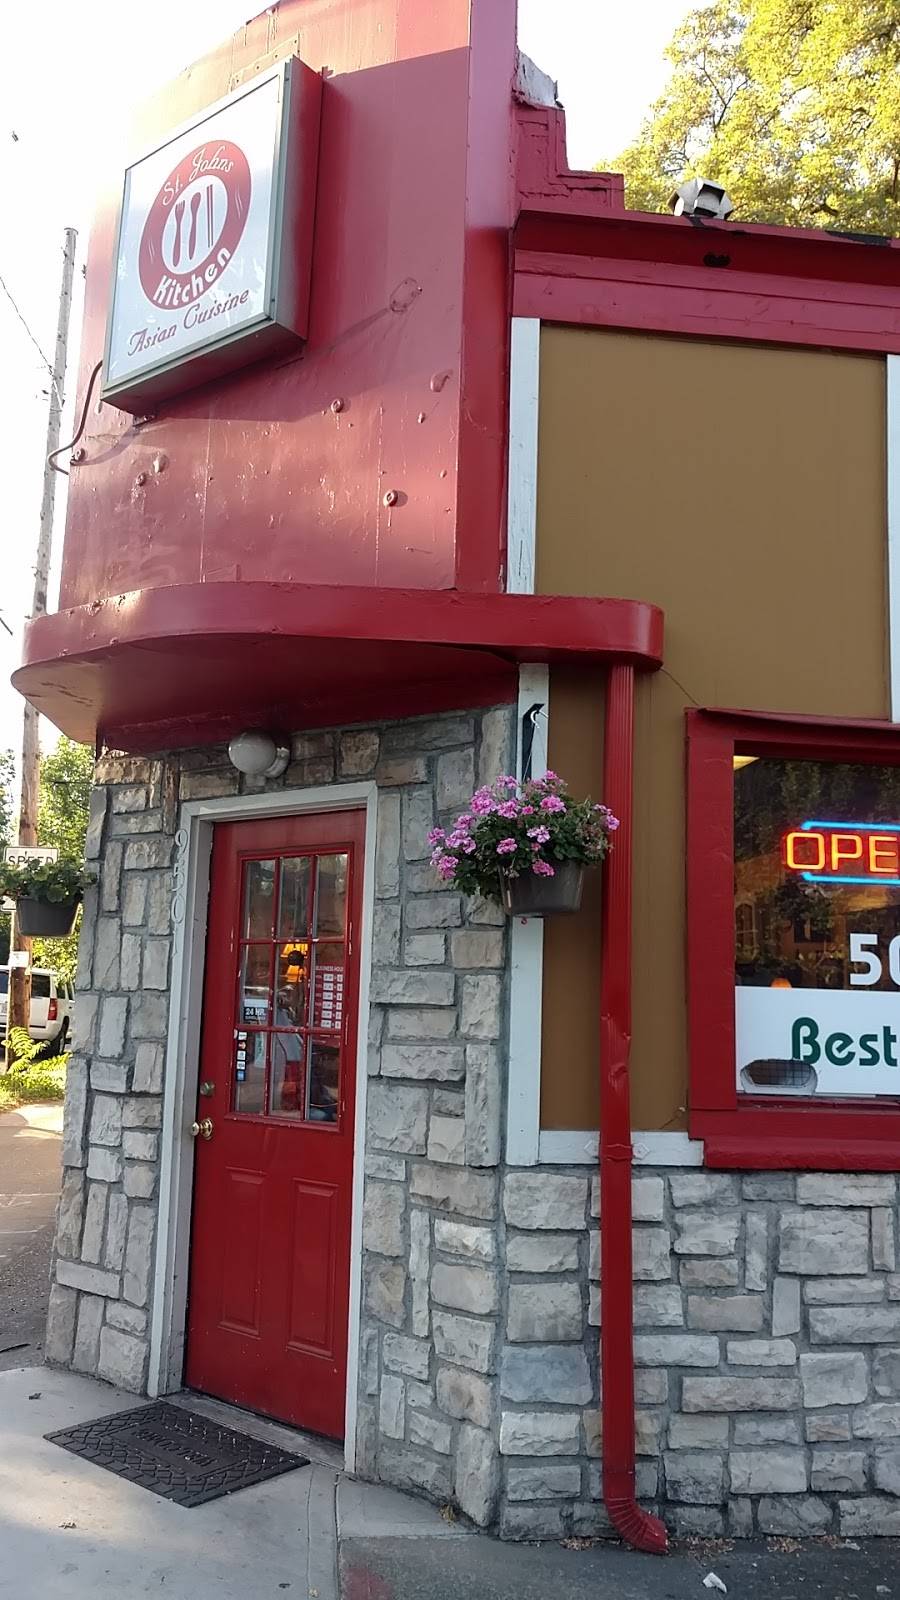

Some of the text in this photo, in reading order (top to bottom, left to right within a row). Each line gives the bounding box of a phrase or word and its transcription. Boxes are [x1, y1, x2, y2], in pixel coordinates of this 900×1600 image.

[162, 145, 234, 206] St. Johns
[153, 247, 231, 307] Kitchen
[127, 289, 249, 357] Asian Cuisine
[791, 1016, 898, 1068] Best
